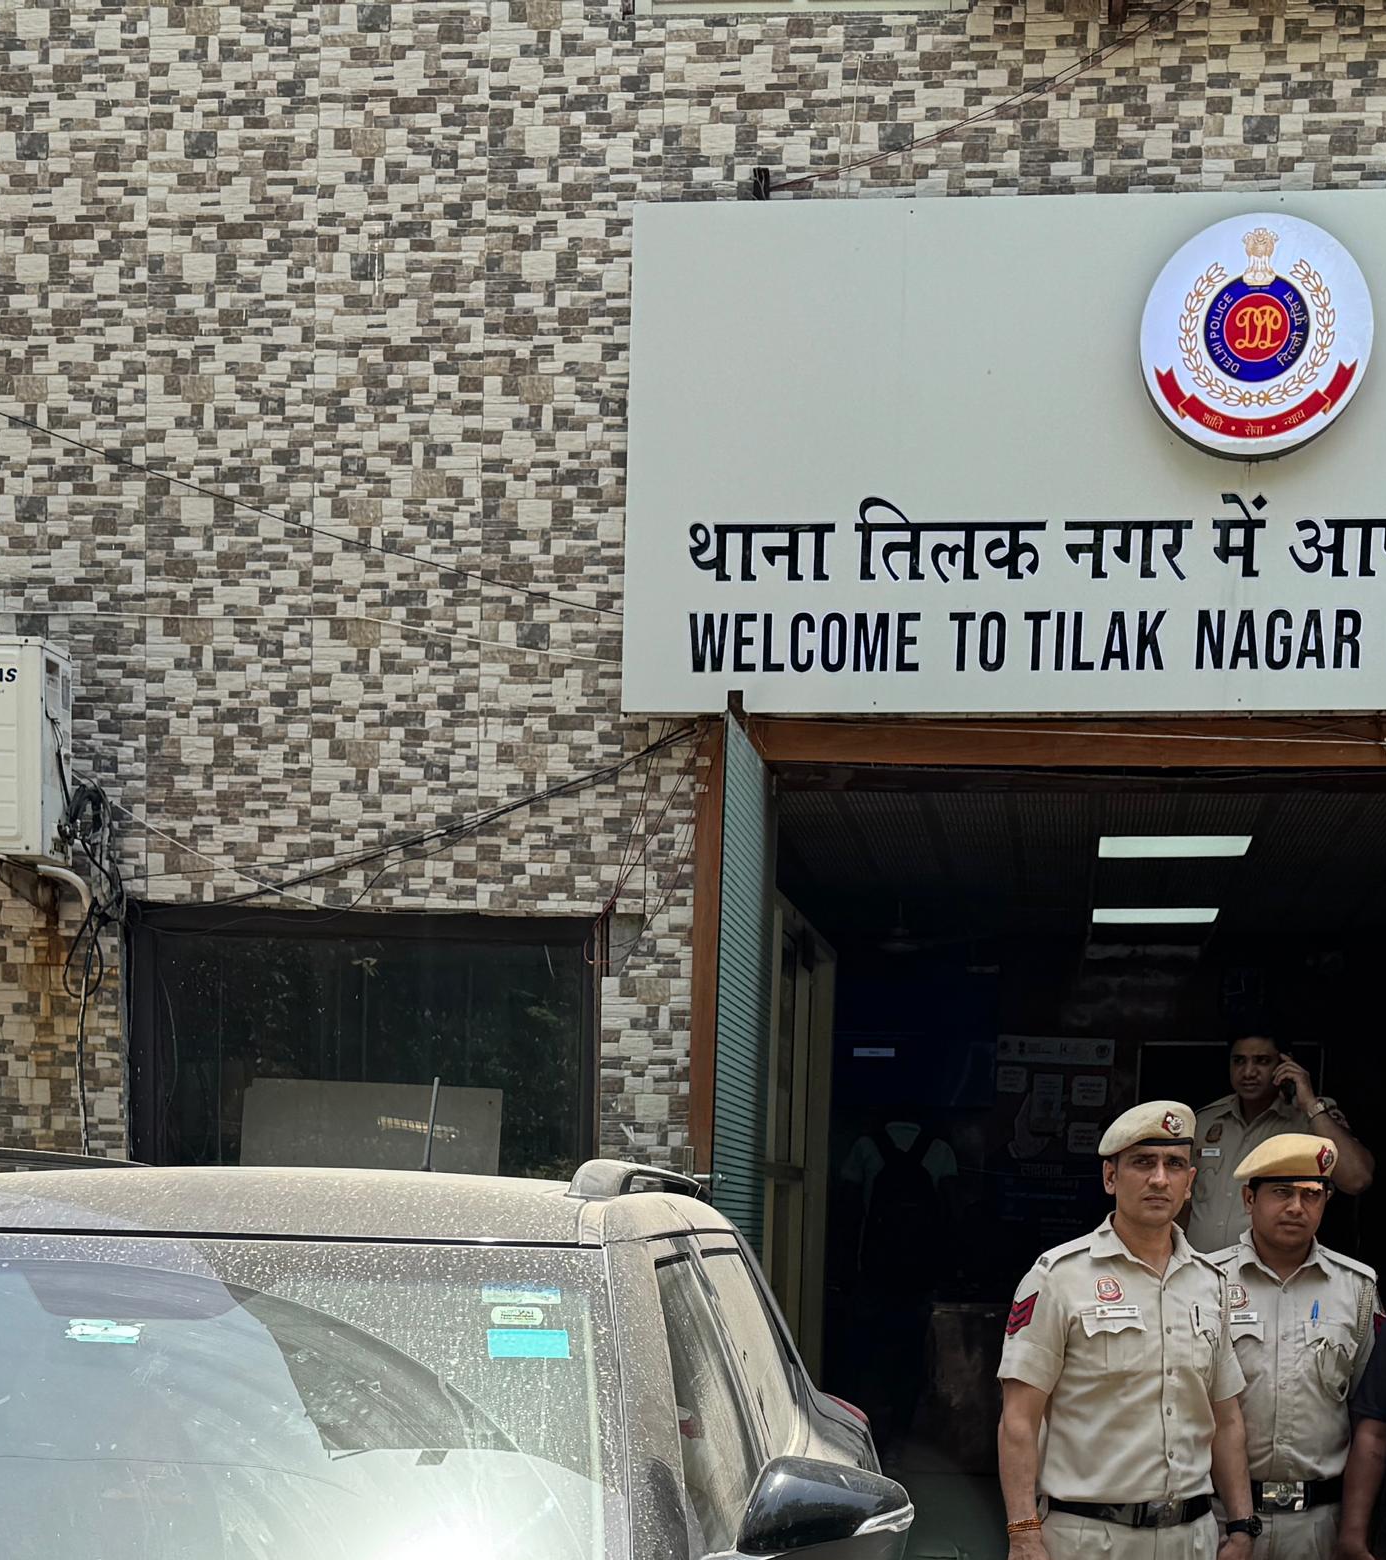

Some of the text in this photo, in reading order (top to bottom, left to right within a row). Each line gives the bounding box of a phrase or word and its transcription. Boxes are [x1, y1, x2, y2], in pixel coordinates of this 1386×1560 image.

[1209, 292, 1240, 373] DELHI POLICE
[689, 521, 836, 581] थाना
[854, 496, 1047, 584] तिलक
[1064, 519, 1193, 580] नगर
[1212, 493, 1268, 578] में
[689, 612, 921, 673] WELCOME
[949, 611, 1007, 672] TO
[1024, 609, 1167, 671] TILAK
[1195, 609, 1362, 671] NAGAR
